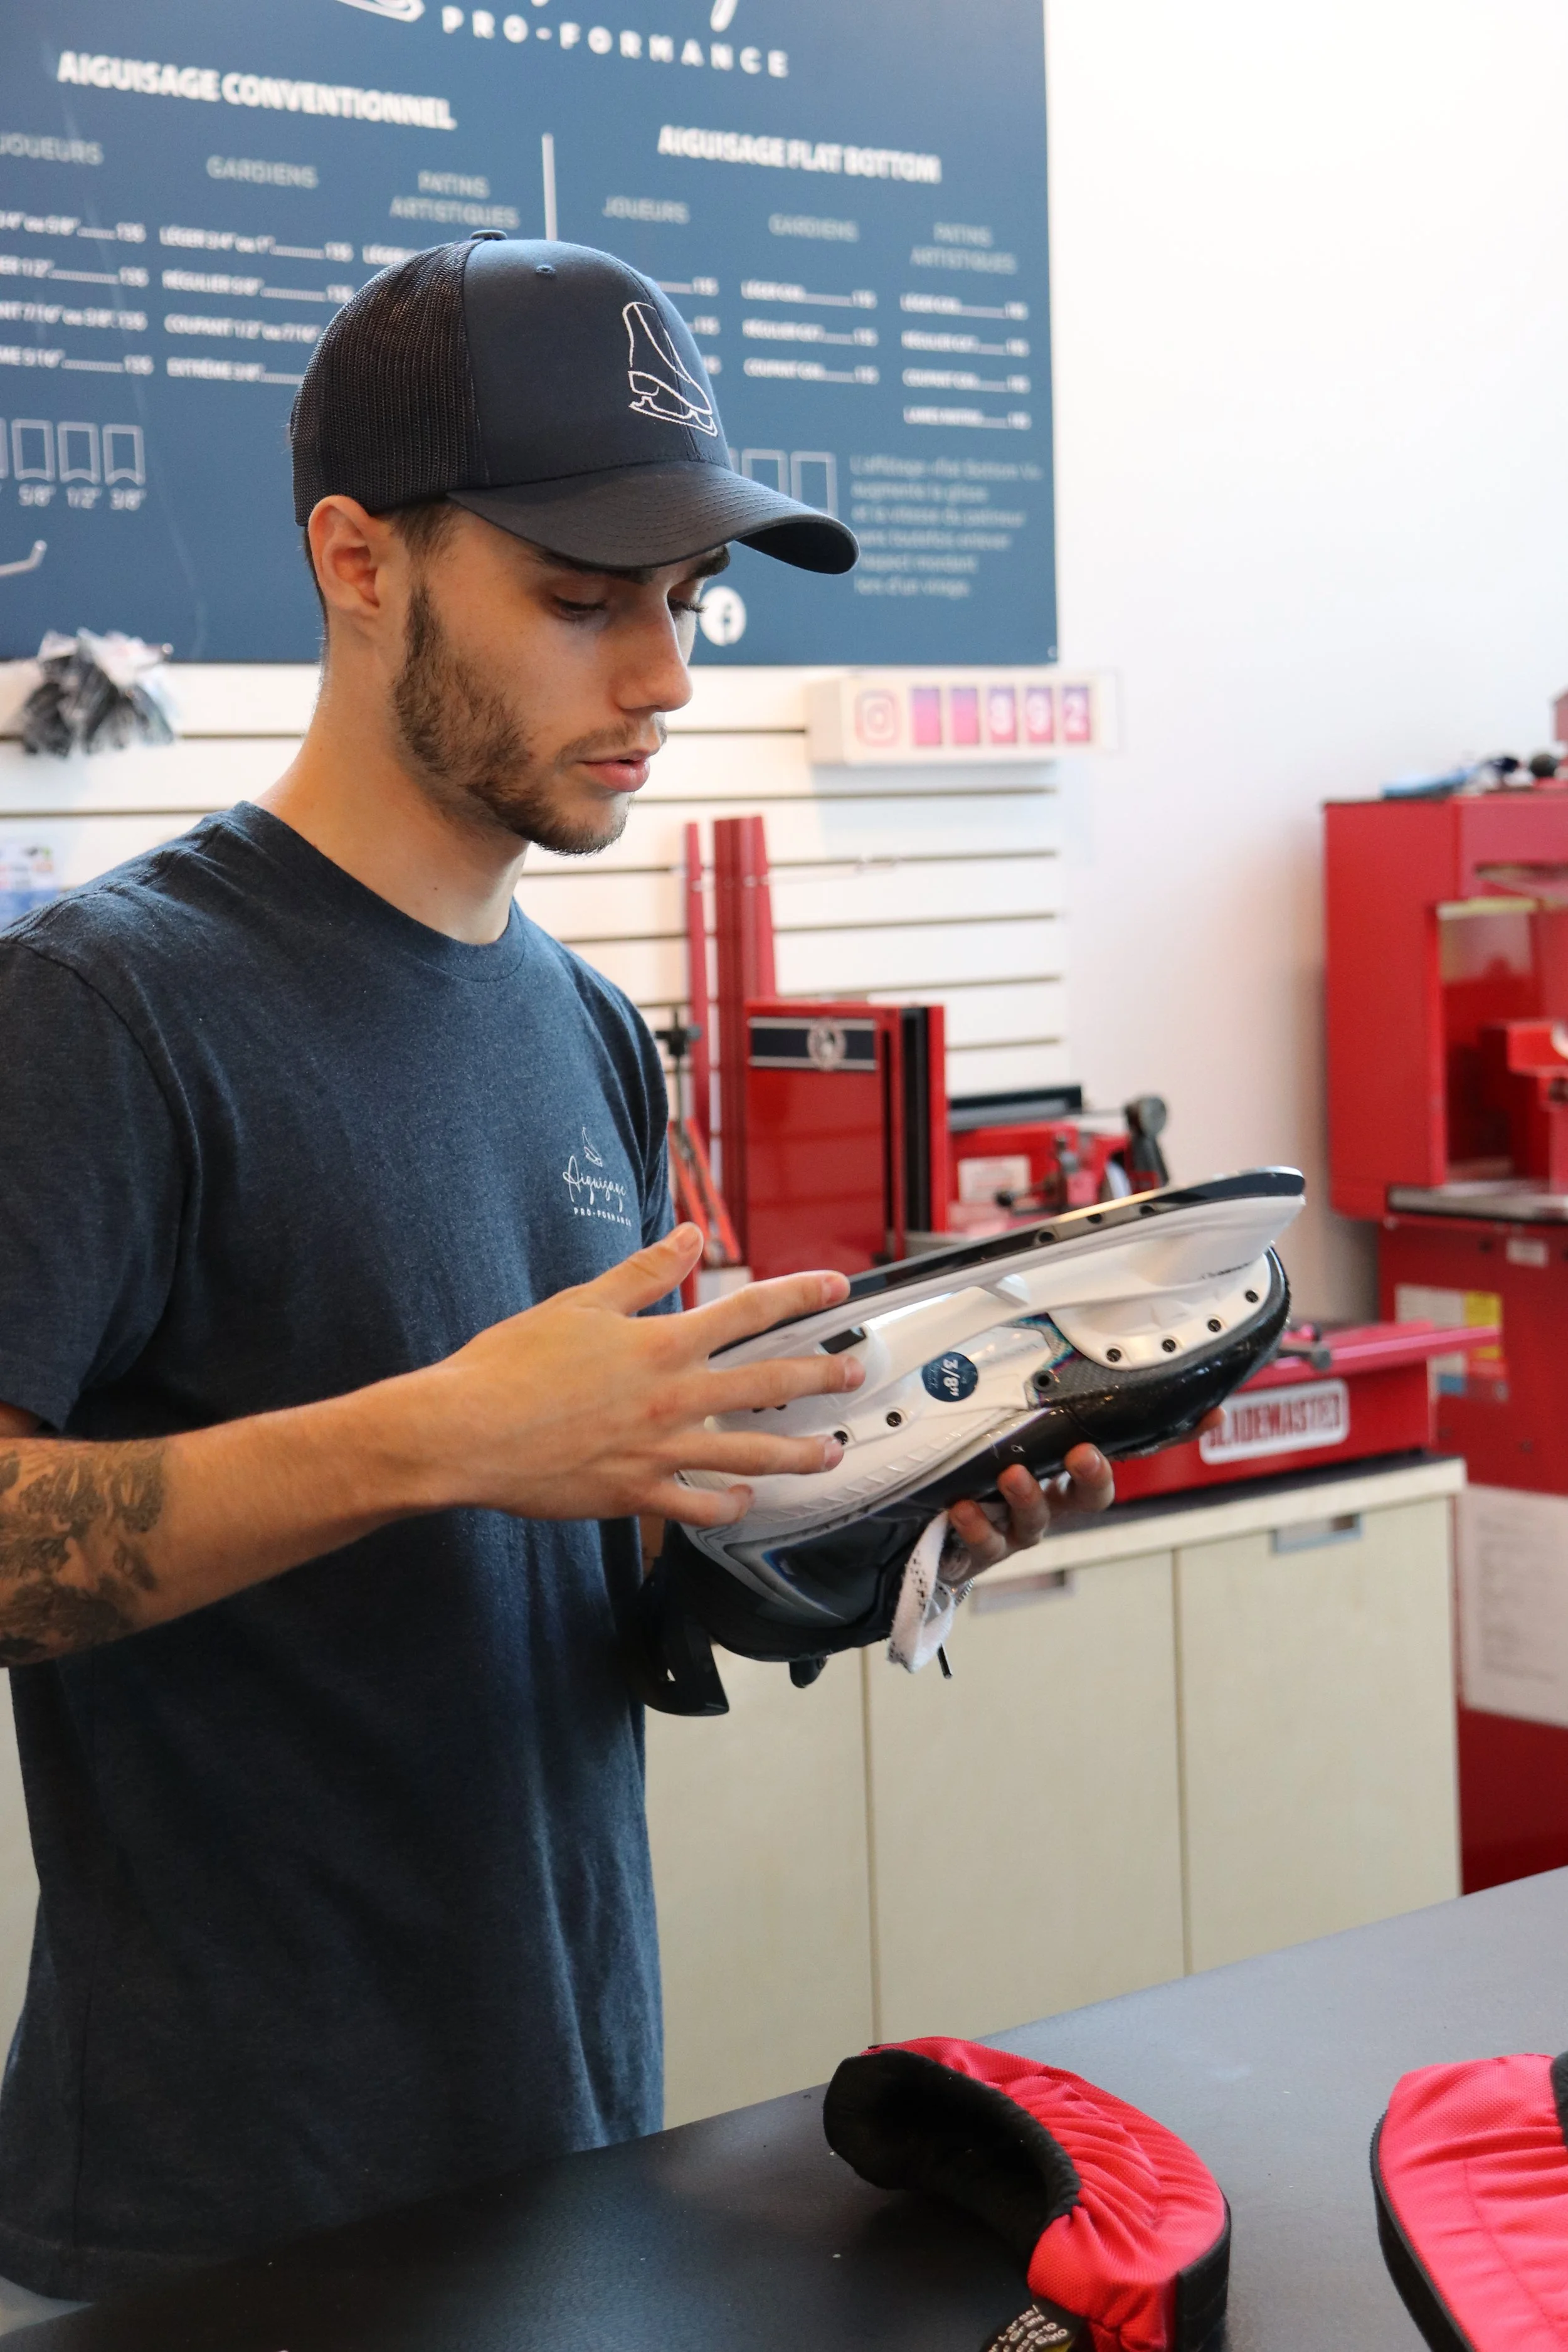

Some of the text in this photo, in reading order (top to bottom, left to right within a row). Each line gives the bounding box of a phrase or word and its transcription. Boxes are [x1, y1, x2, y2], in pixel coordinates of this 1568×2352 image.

[441, 5, 788, 78] PRO-FORMANCE
[57, 51, 457, 130] AIGUISAGE CONVENTIONNEL
[206, 154, 319, 189] GARDIENS
[657, 124, 941, 184] AIGUISAGE FLAT BOTTOM
[417, 169, 490, 199] PATINS
[389, 196, 521, 230] ARTISTIQUES
[602, 196, 690, 225] JOUEURS
[768, 213, 860, 243] GARDIENS
[563, 1155, 627, 1213] Aiguisage
[573, 1207, 632, 1227] PRO-FORMANCE
[941, 1359, 961, 1397] 3/8"
